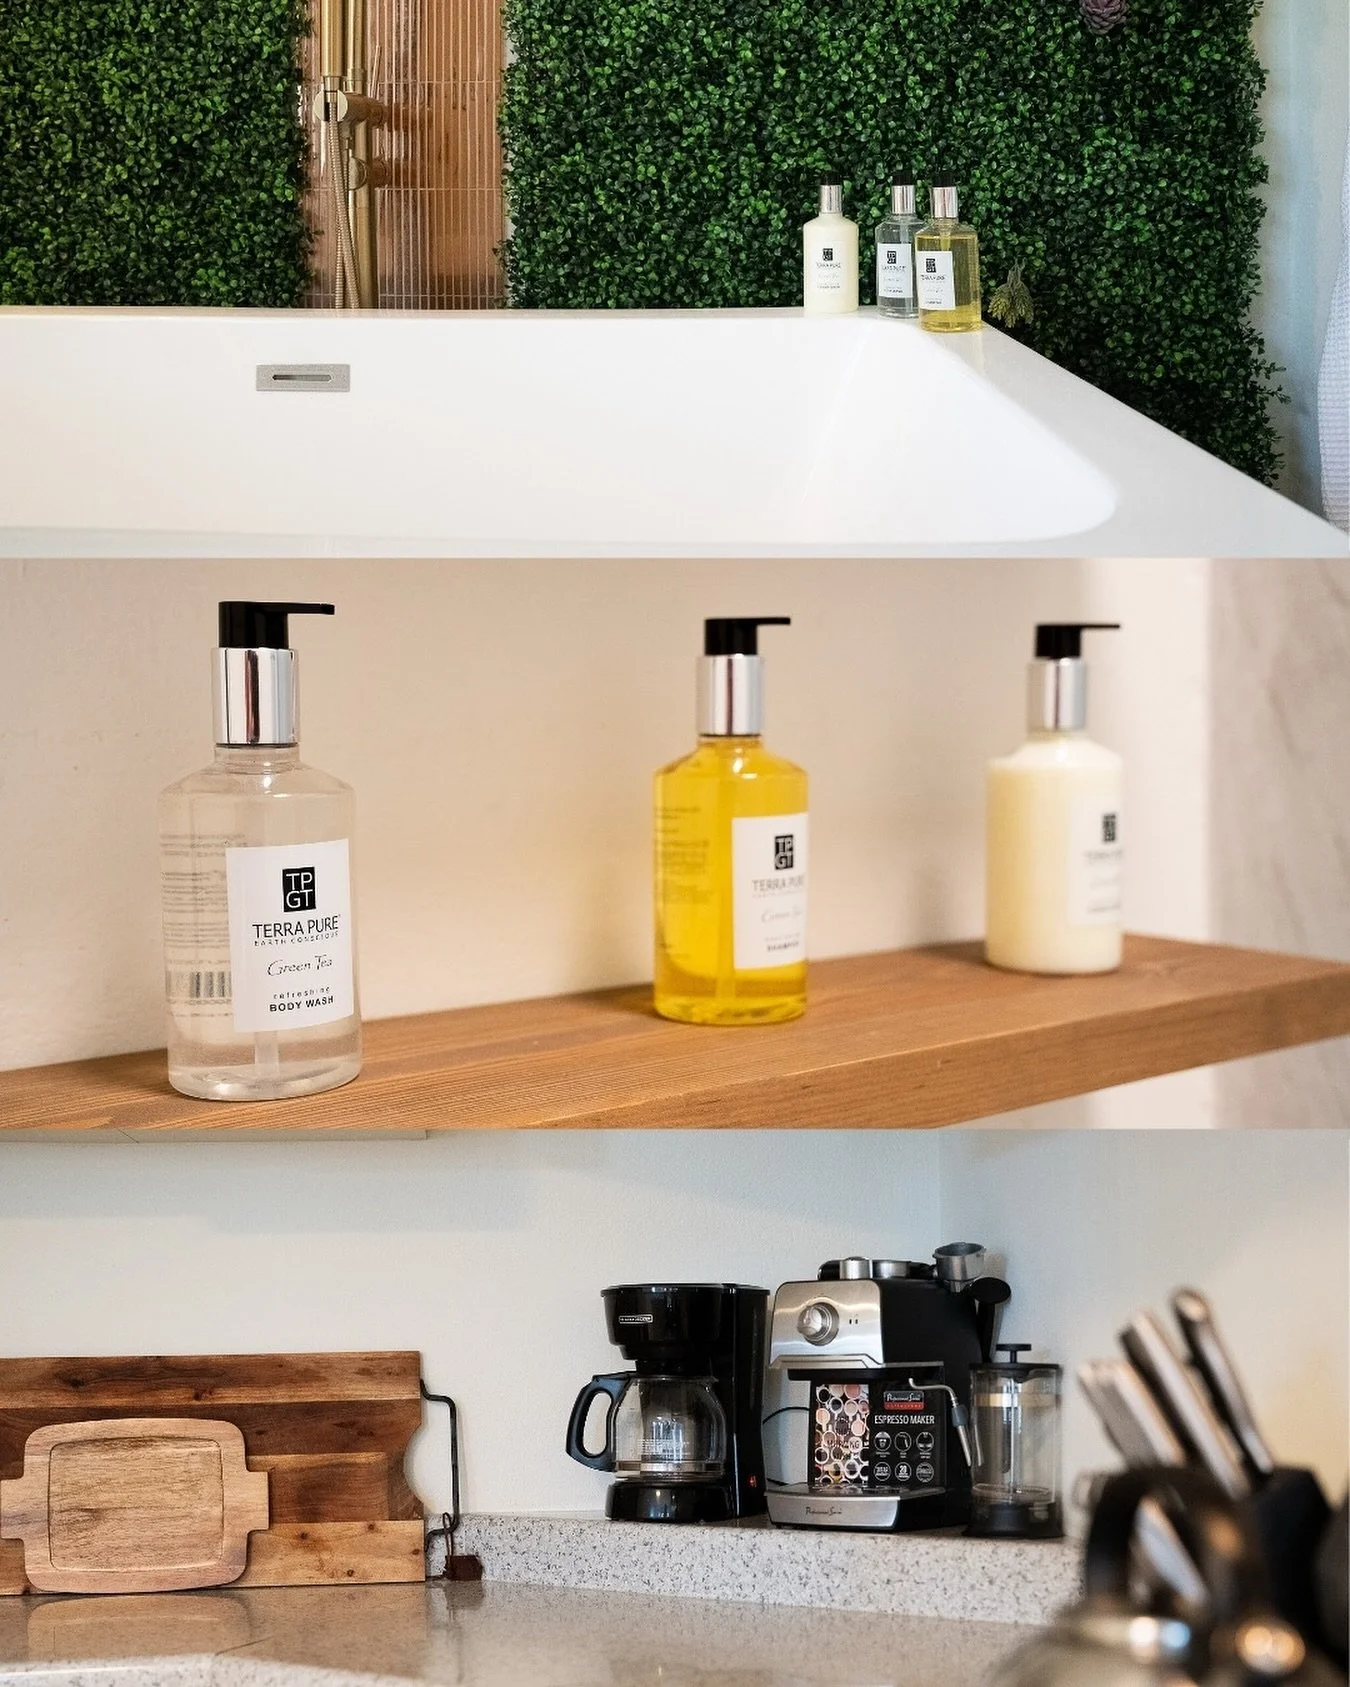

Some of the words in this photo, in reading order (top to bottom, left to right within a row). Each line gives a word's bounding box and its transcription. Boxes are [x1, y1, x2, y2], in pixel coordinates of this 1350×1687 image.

[777, 837, 793, 853] TP
[775, 851, 793, 868] GT
[285, 872, 313, 891] TP
[286, 889, 314, 909] GT
[252, 921, 304, 938] TERRA
[308, 915, 339, 934] PURE
[254, 938, 287, 947] EARTH
[267, 959, 311, 977] Green
[314, 954, 333, 971] Tea
[269, 1001, 302, 1012] BODY
[305, 996, 334, 1008] WASH
[874, 1414, 909, 1425] ESPRESSO
[910, 1414, 935, 1425] MAKER
